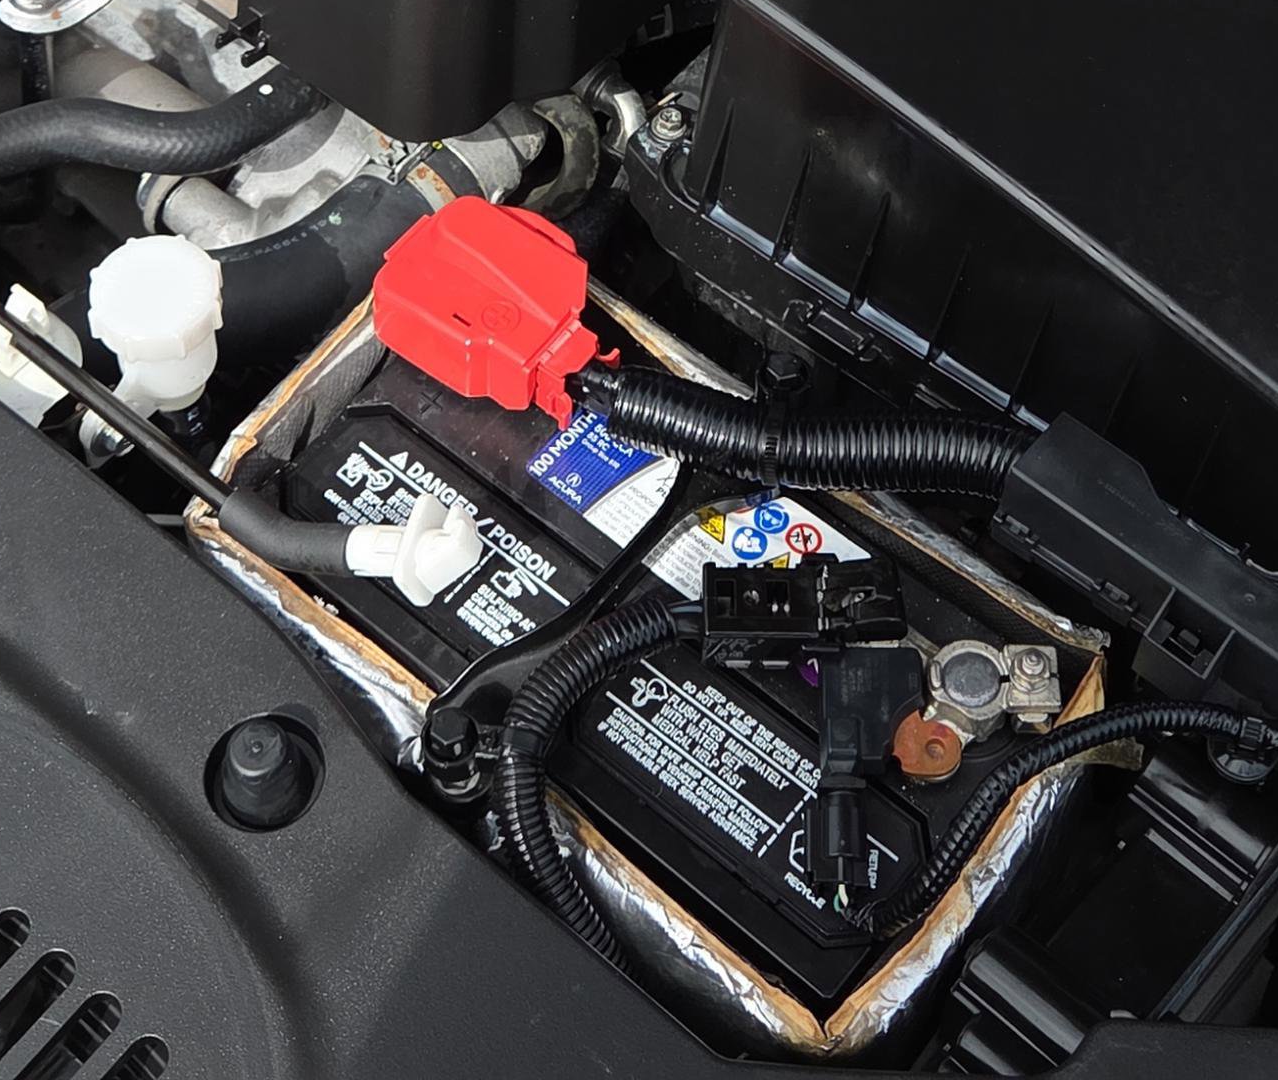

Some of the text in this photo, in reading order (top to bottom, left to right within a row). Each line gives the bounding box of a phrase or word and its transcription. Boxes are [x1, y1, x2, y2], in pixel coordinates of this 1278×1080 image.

[529, 412, 598, 477] 100 MONTH
[586, 430, 610, 451] 85 RC
[323, 488, 341, 504] CAN
[351, 495, 384, 524] GASES
[359, 487, 407, 528] EXPLOSIVE
[386, 494, 412, 517] EYES
[404, 461, 480, 517] DANGER
[487, 524, 557, 581] POISON
[549, 477, 583, 504] ACURA
[470, 592, 487, 608] CAN
[651, 713, 746, 790] MEDICAL HELP FAST
[660, 703, 687, 729] WITH
[721, 751, 744, 772] GET
[667, 693, 701, 723] FLUSH
[697, 716, 727, 743] EYES
[724, 737, 790, 790] IMMEDIATELY
[682, 680, 697, 694] DO
[695, 690, 714, 707] NOT
[728, 716, 752, 737] KEEP
[749, 732, 773, 754] VENT
[771, 749, 795, 770] CAPS
[703, 684, 814, 772] KEEP OUT OF THE REACH OF
[604, 727, 623, 745] NOT
[620, 740, 660, 774] AVAILABLE
[657, 769, 680, 790] SEEK
[676, 783, 711, 814] SERVICE
[605, 714, 658, 758] INSTRUCTIONS
[664, 761, 698, 790] VEHICLE
[694, 785, 729, 815] OWNERS
[644, 732, 662, 749] FOR
[659, 744, 682, 764] SAFE
[678, 758, 703, 781] JUMP
[699, 775, 738, 809] STARTING
[735, 804, 770, 834] FOLLOW
